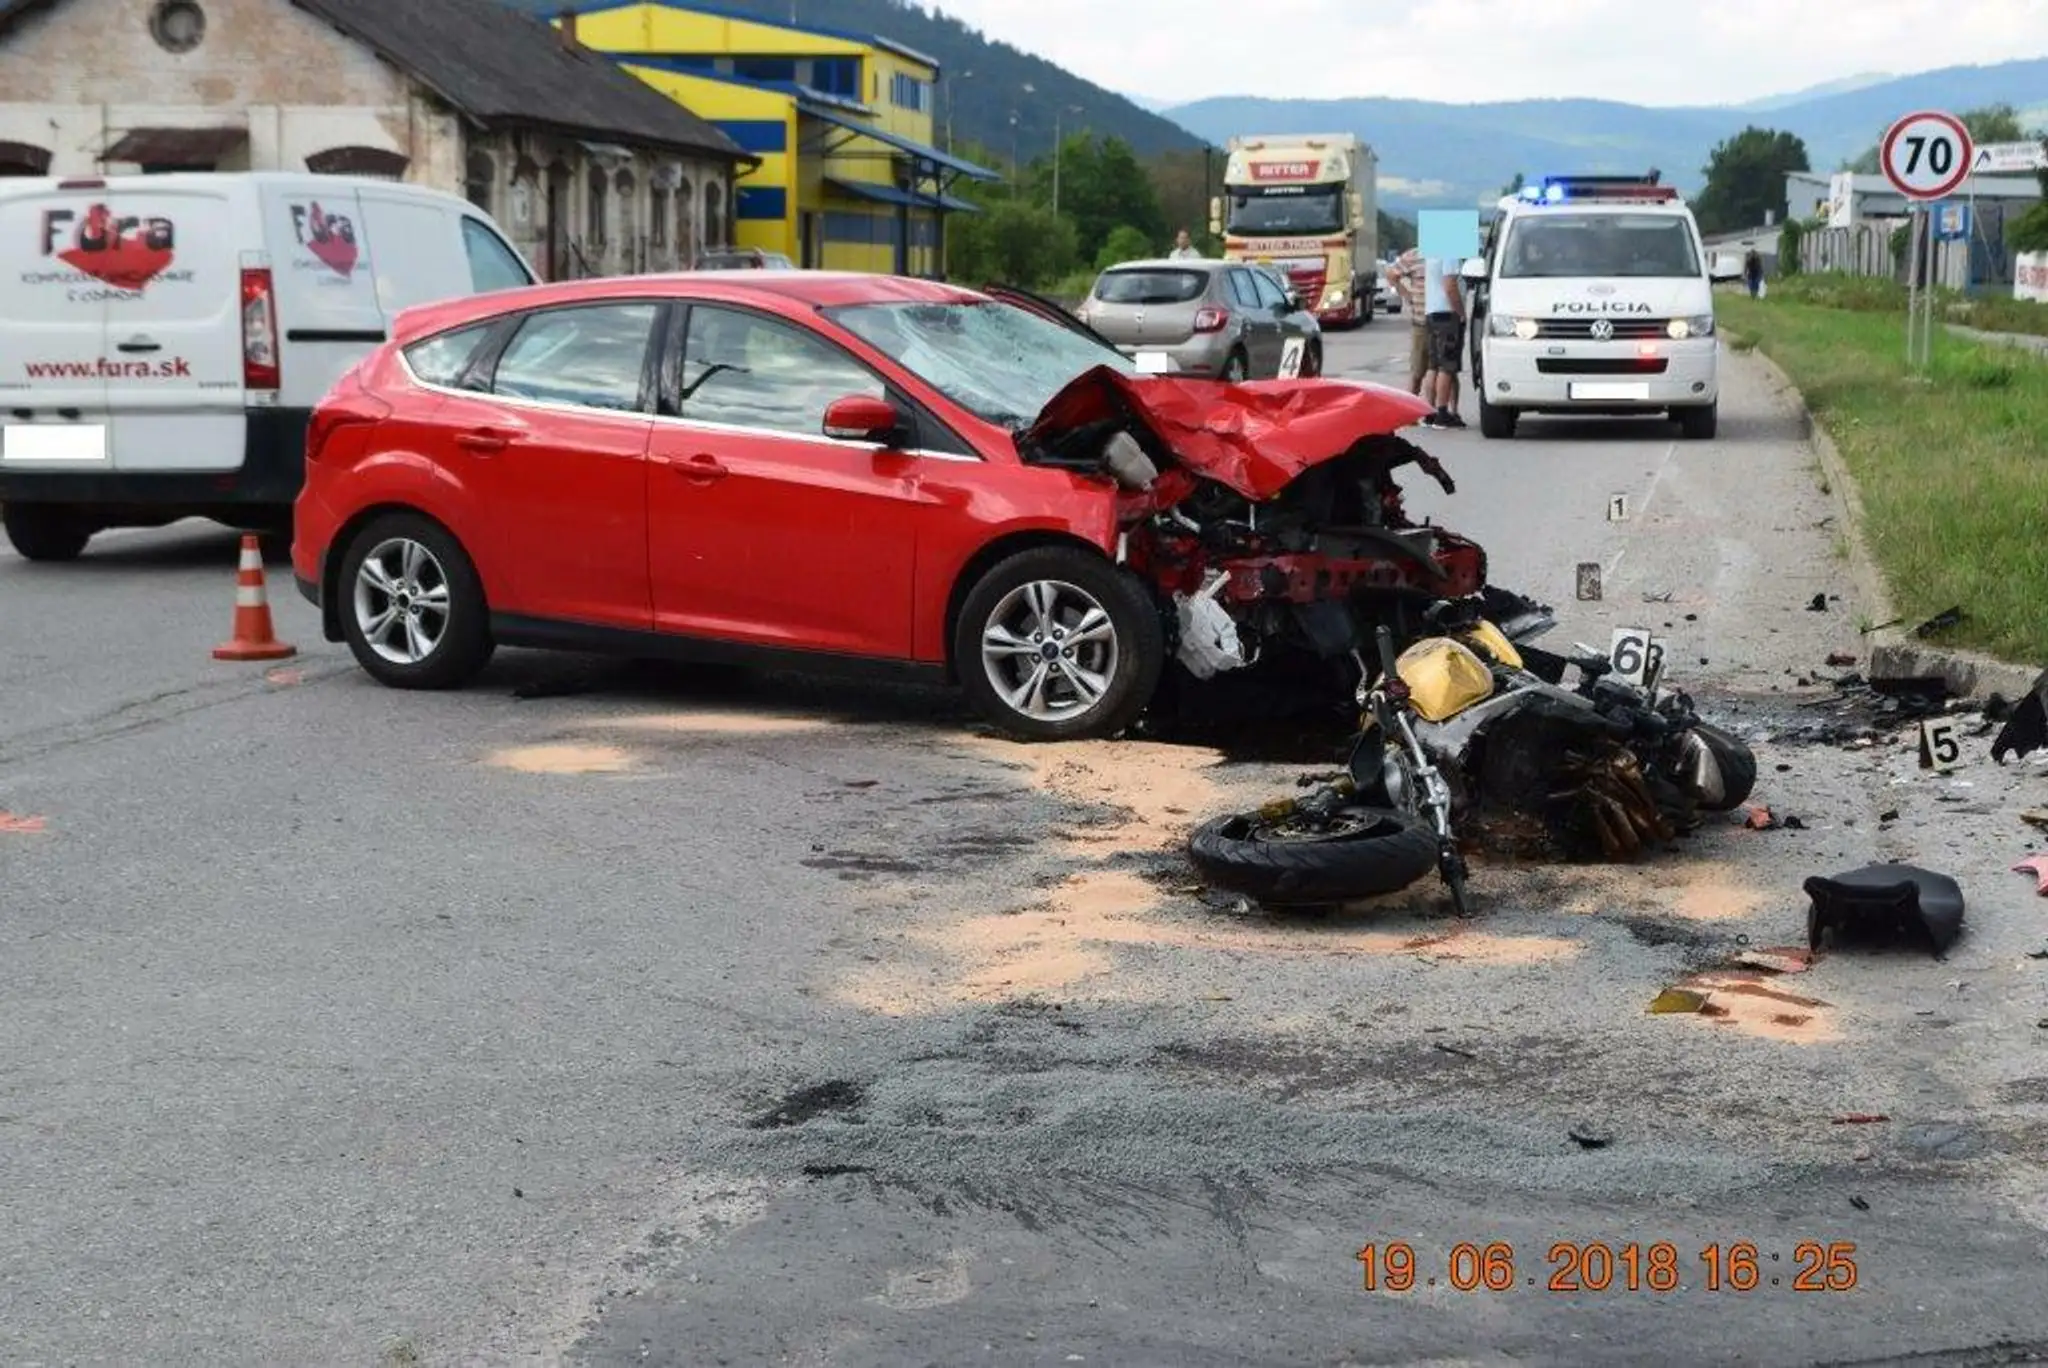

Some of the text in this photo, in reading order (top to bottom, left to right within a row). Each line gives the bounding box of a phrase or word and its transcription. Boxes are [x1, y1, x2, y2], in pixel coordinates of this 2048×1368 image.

[1905, 137, 1952, 175] 70
[25, 356, 191, 378] www.fura.sk
[1283, 346, 1298, 376] 4
[1614, 498, 1623, 516] 1
[1613, 636, 1643, 675] 6
[1932, 726, 1959, 763] 5
